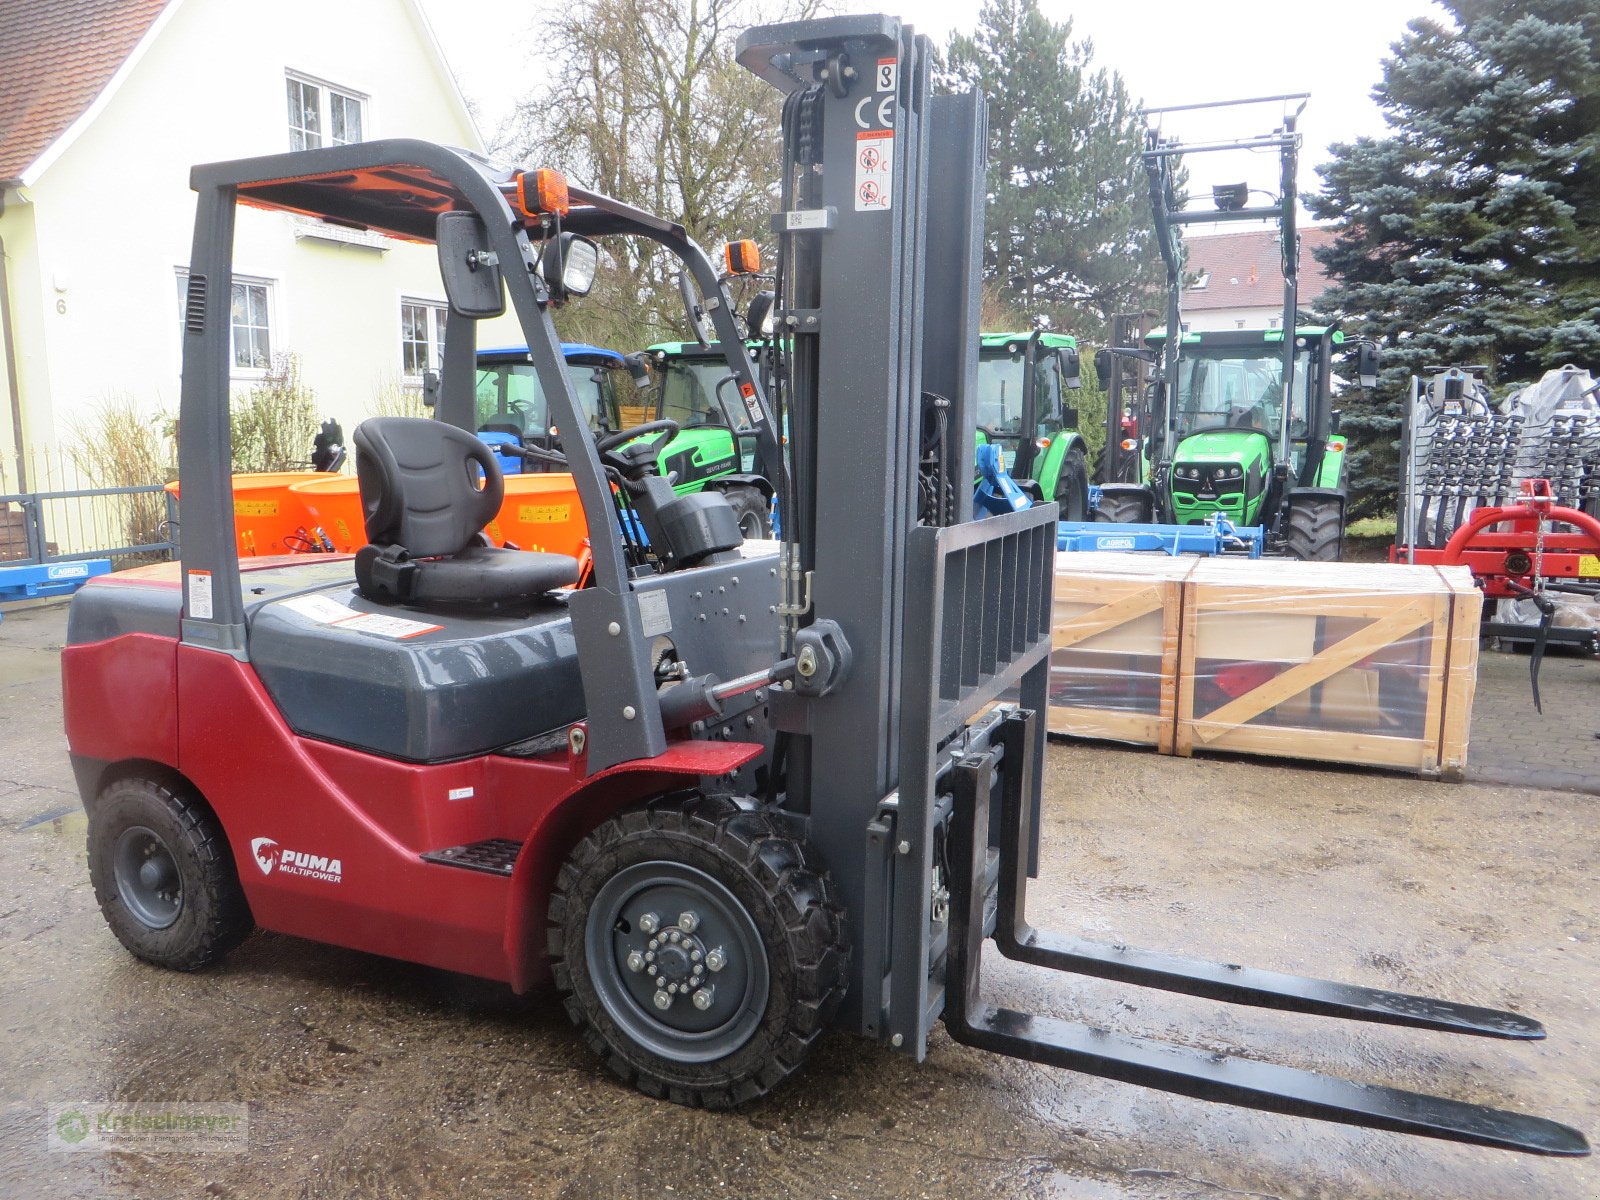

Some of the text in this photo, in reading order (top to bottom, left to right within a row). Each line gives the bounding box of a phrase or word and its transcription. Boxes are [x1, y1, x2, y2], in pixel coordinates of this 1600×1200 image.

[855, 95, 895, 129] CE
[56, 298, 67, 315] 6
[281, 849, 342, 875] PUMA
[279, 864, 342, 884] MULTIPOWER
